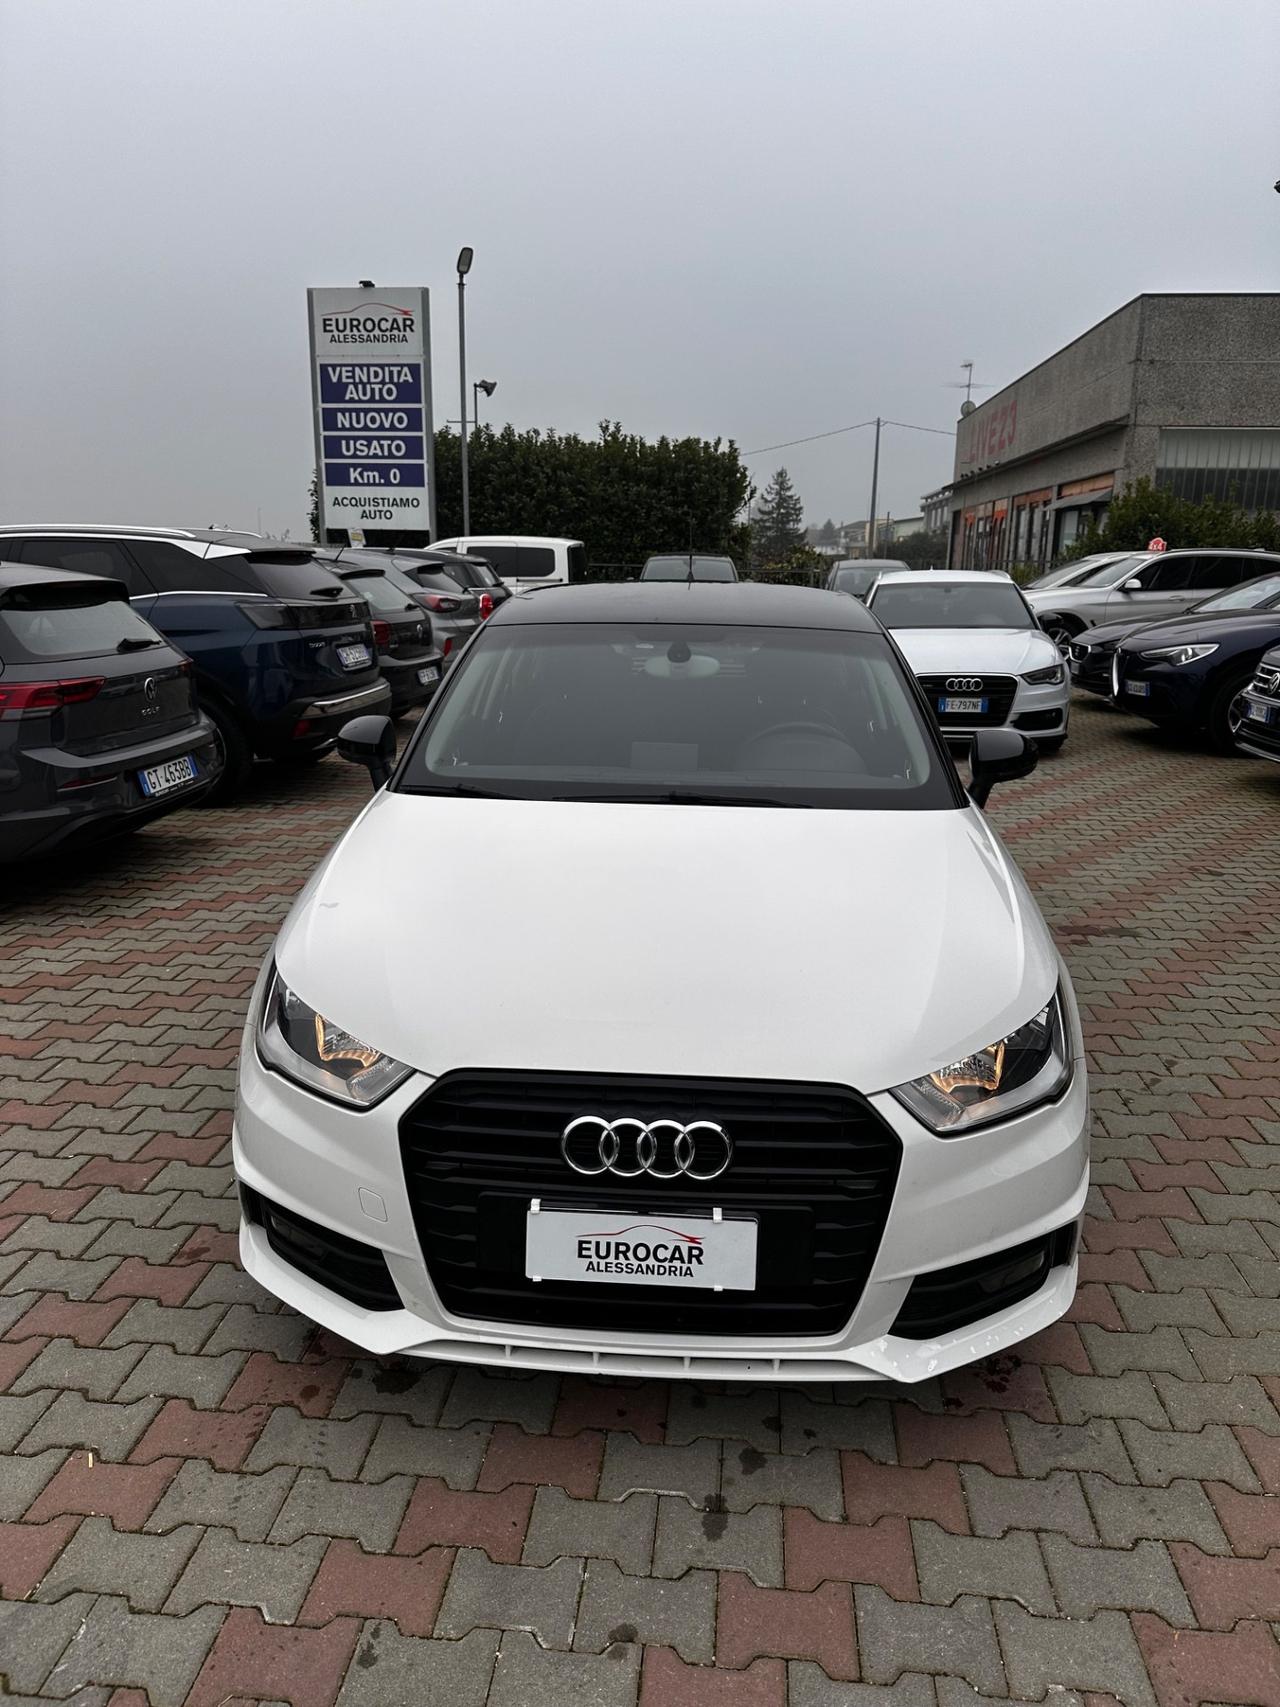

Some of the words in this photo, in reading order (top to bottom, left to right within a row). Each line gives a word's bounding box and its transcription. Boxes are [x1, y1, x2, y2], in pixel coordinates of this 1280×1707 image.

[322, 317, 415, 333] EUROCAR
[329, 334, 409, 344] ALESSANDRIA
[327, 366, 413, 383] VENDITA
[344, 384, 398, 400] AUTO
[337, 412, 408, 429] NUOVO
[341, 440, 406, 456] USATO
[349, 467, 385, 484] Km.
[390, 468, 401, 484] 0
[332, 497, 420, 508] ACQUISTIAMO
[360, 509, 393, 520] AUTO
[577, 1239, 705, 1266] EUROCAR
[585, 1260, 694, 1278] ALESSANDRIA
